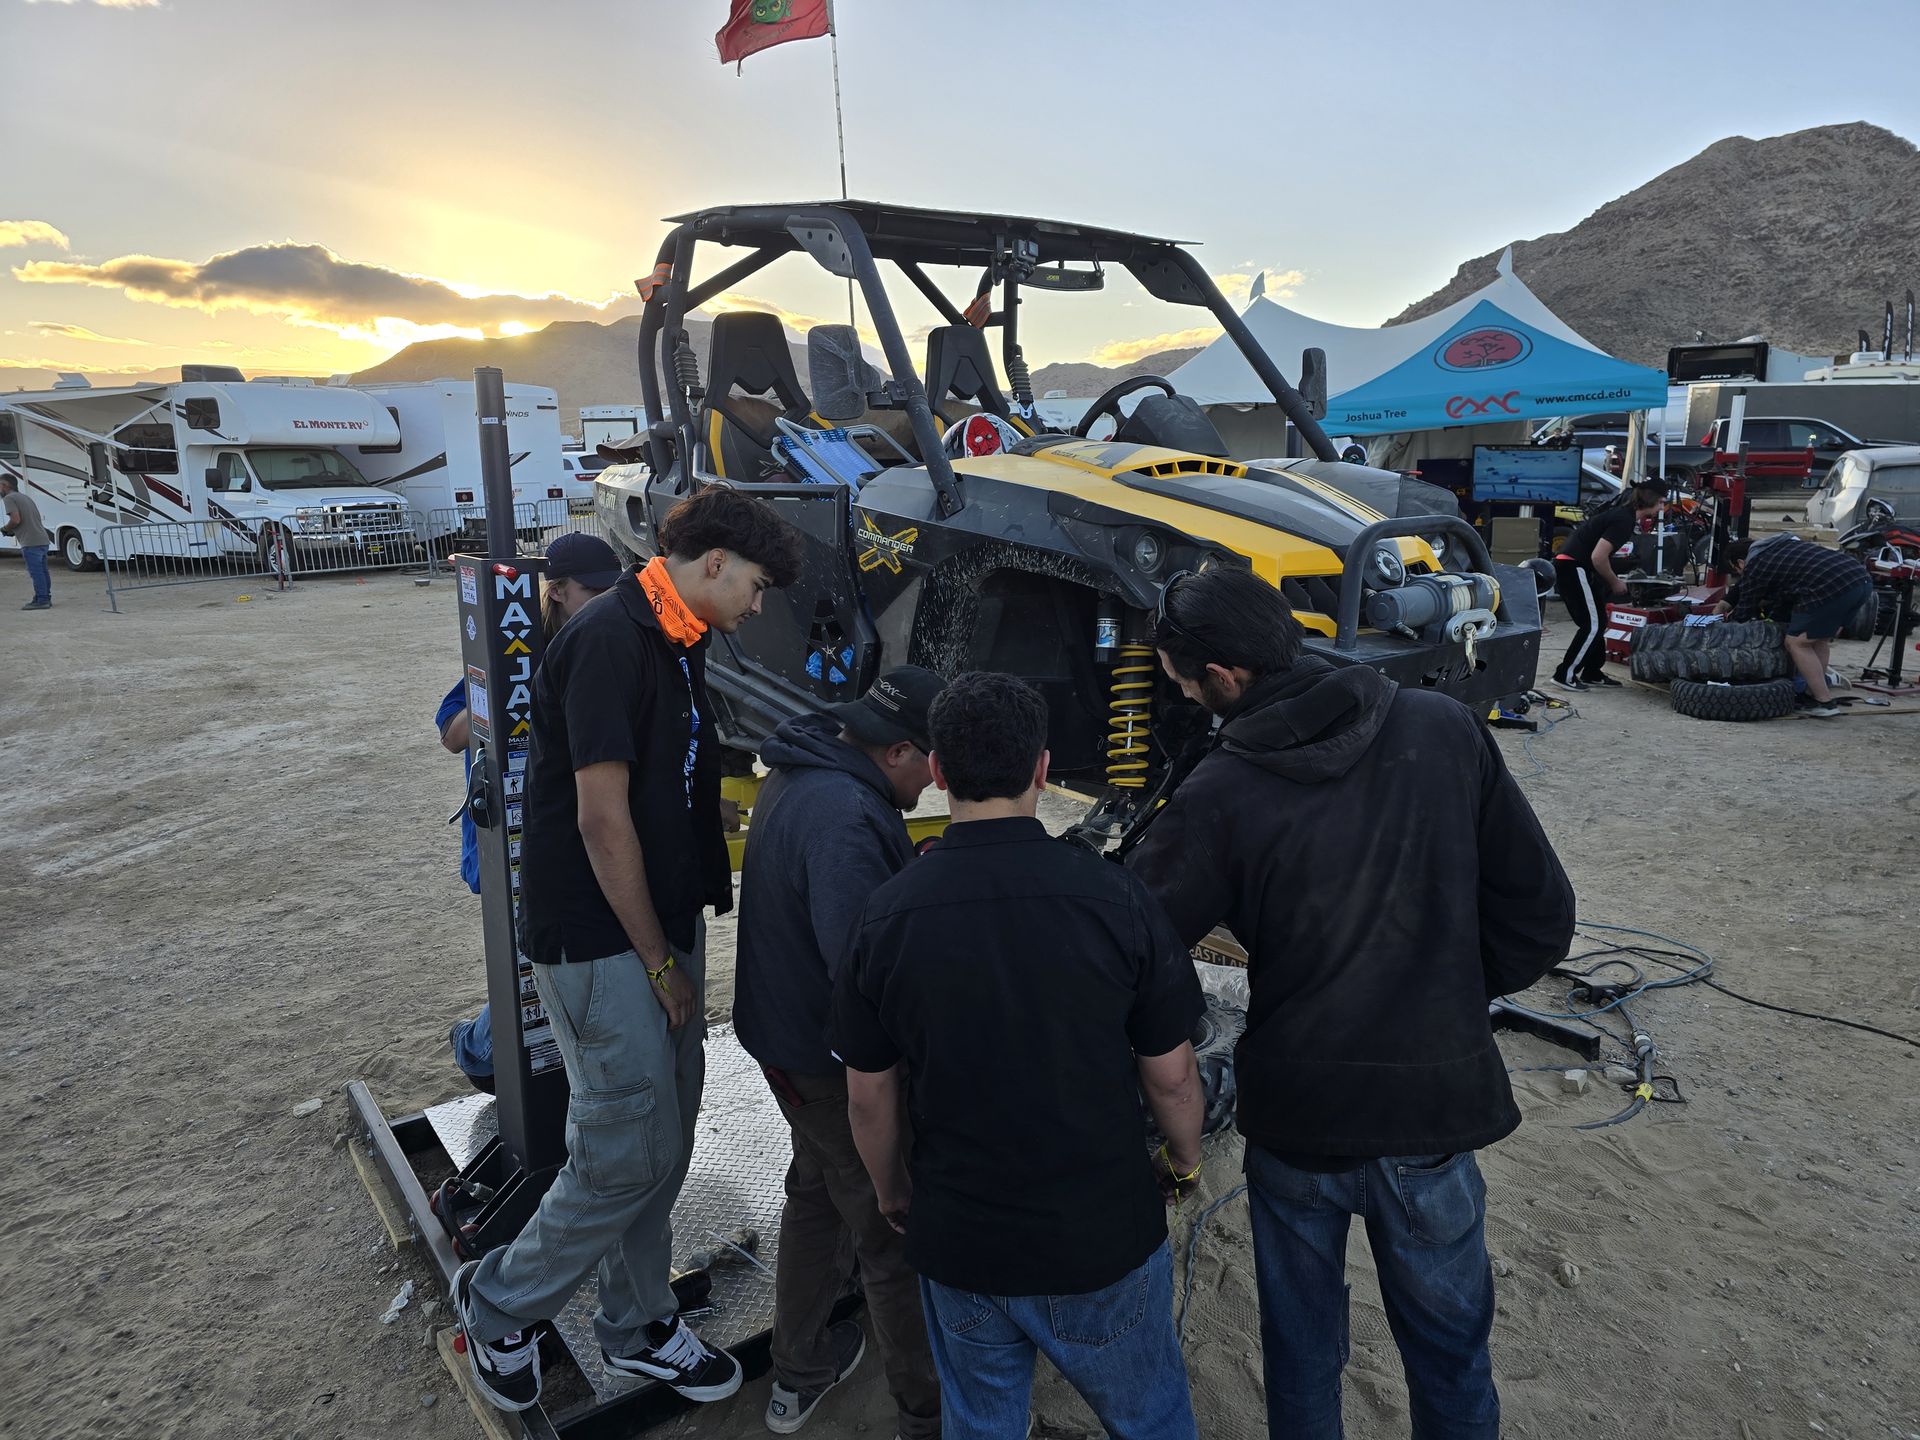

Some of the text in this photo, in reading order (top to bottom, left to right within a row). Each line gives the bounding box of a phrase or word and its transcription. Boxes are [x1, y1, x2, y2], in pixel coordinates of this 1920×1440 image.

[1535, 387, 1631, 405] www.cmccd.edu
[1345, 408, 1407, 422] Joshua Tree
[292, 420, 363, 430] EL MONTE RV
[857, 528, 914, 554] COMMANDER
